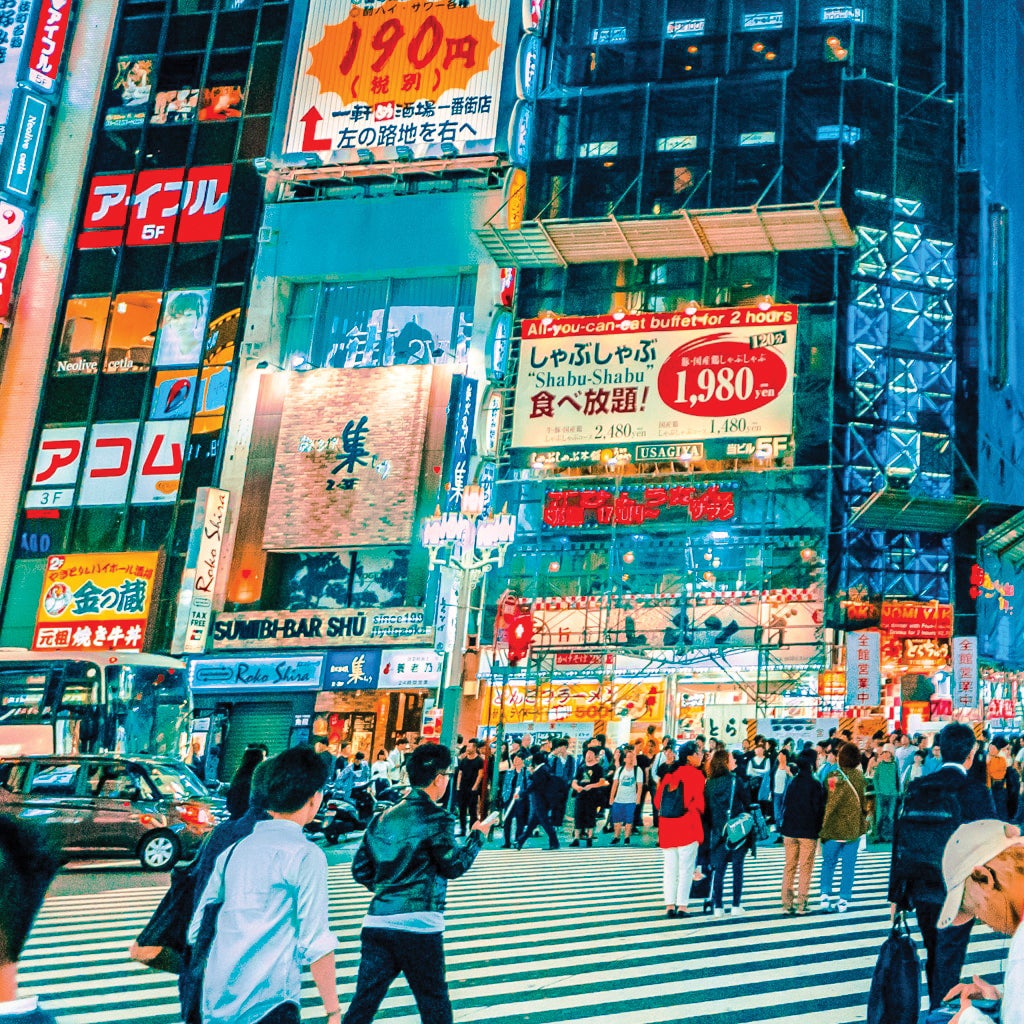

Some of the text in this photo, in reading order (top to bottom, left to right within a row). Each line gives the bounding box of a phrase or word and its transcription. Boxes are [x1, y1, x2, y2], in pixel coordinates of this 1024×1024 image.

[36, 7, 63, 74] アイフル
[339, 15, 480, 77] 190円
[337, 120, 478, 149] 左の路地を右へ
[89, 178, 228, 221] アイフル
[141, 224, 166, 240] 5F
[527, 309, 793, 337] All-you-can-eat buffet for 2 hours
[57, 359, 98, 372] Neolive
[530, 338, 658, 369] しゃぶしゃぶ
[673, 366, 775, 408] 1,980 yen
[594, 422, 632, 440] 2,480
[710, 417, 747, 434] 1,480
[35, 434, 183, 483] アコム
[755, 436, 788, 458] 5F
[40, 491, 63, 505] 3F
[72, 578, 147, 614] 金の蔵
[190, 618, 207, 627] FREE
[192, 610, 206, 619] TAX
[72, 625, 142, 647] 焼き牛丼
[214, 616, 323, 642] SUMIBI-BAR
[857, 633, 870, 705] 全館営業中
